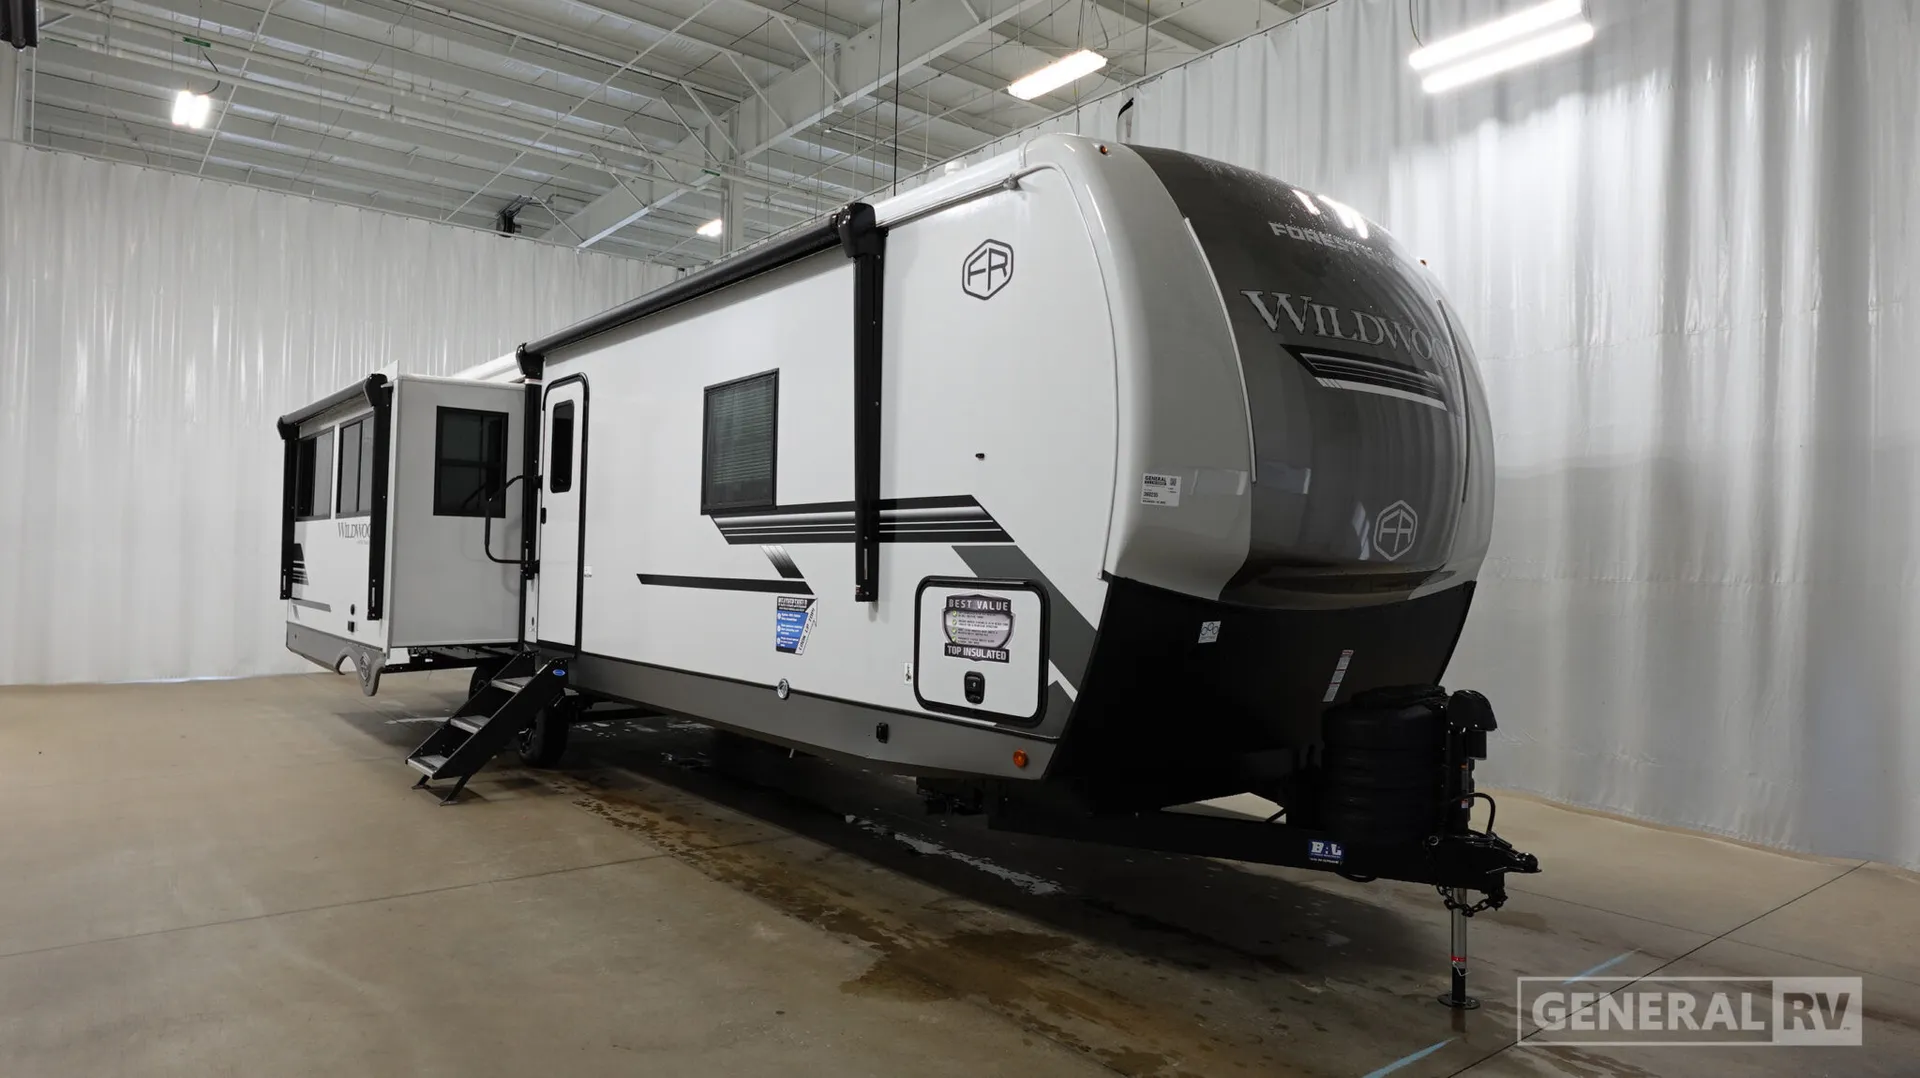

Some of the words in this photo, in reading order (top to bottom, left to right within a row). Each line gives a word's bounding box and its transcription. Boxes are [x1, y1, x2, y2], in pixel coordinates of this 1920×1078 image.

[967, 247, 1009, 292] FR
[1240, 290, 1454, 370] WILDWOO
[1378, 508, 1415, 552] FR
[949, 599, 972, 608] BEST
[977, 600, 1009, 611] VALUE
[947, 645, 962, 655] TOP
[963, 647, 1006, 660] INSULATED
